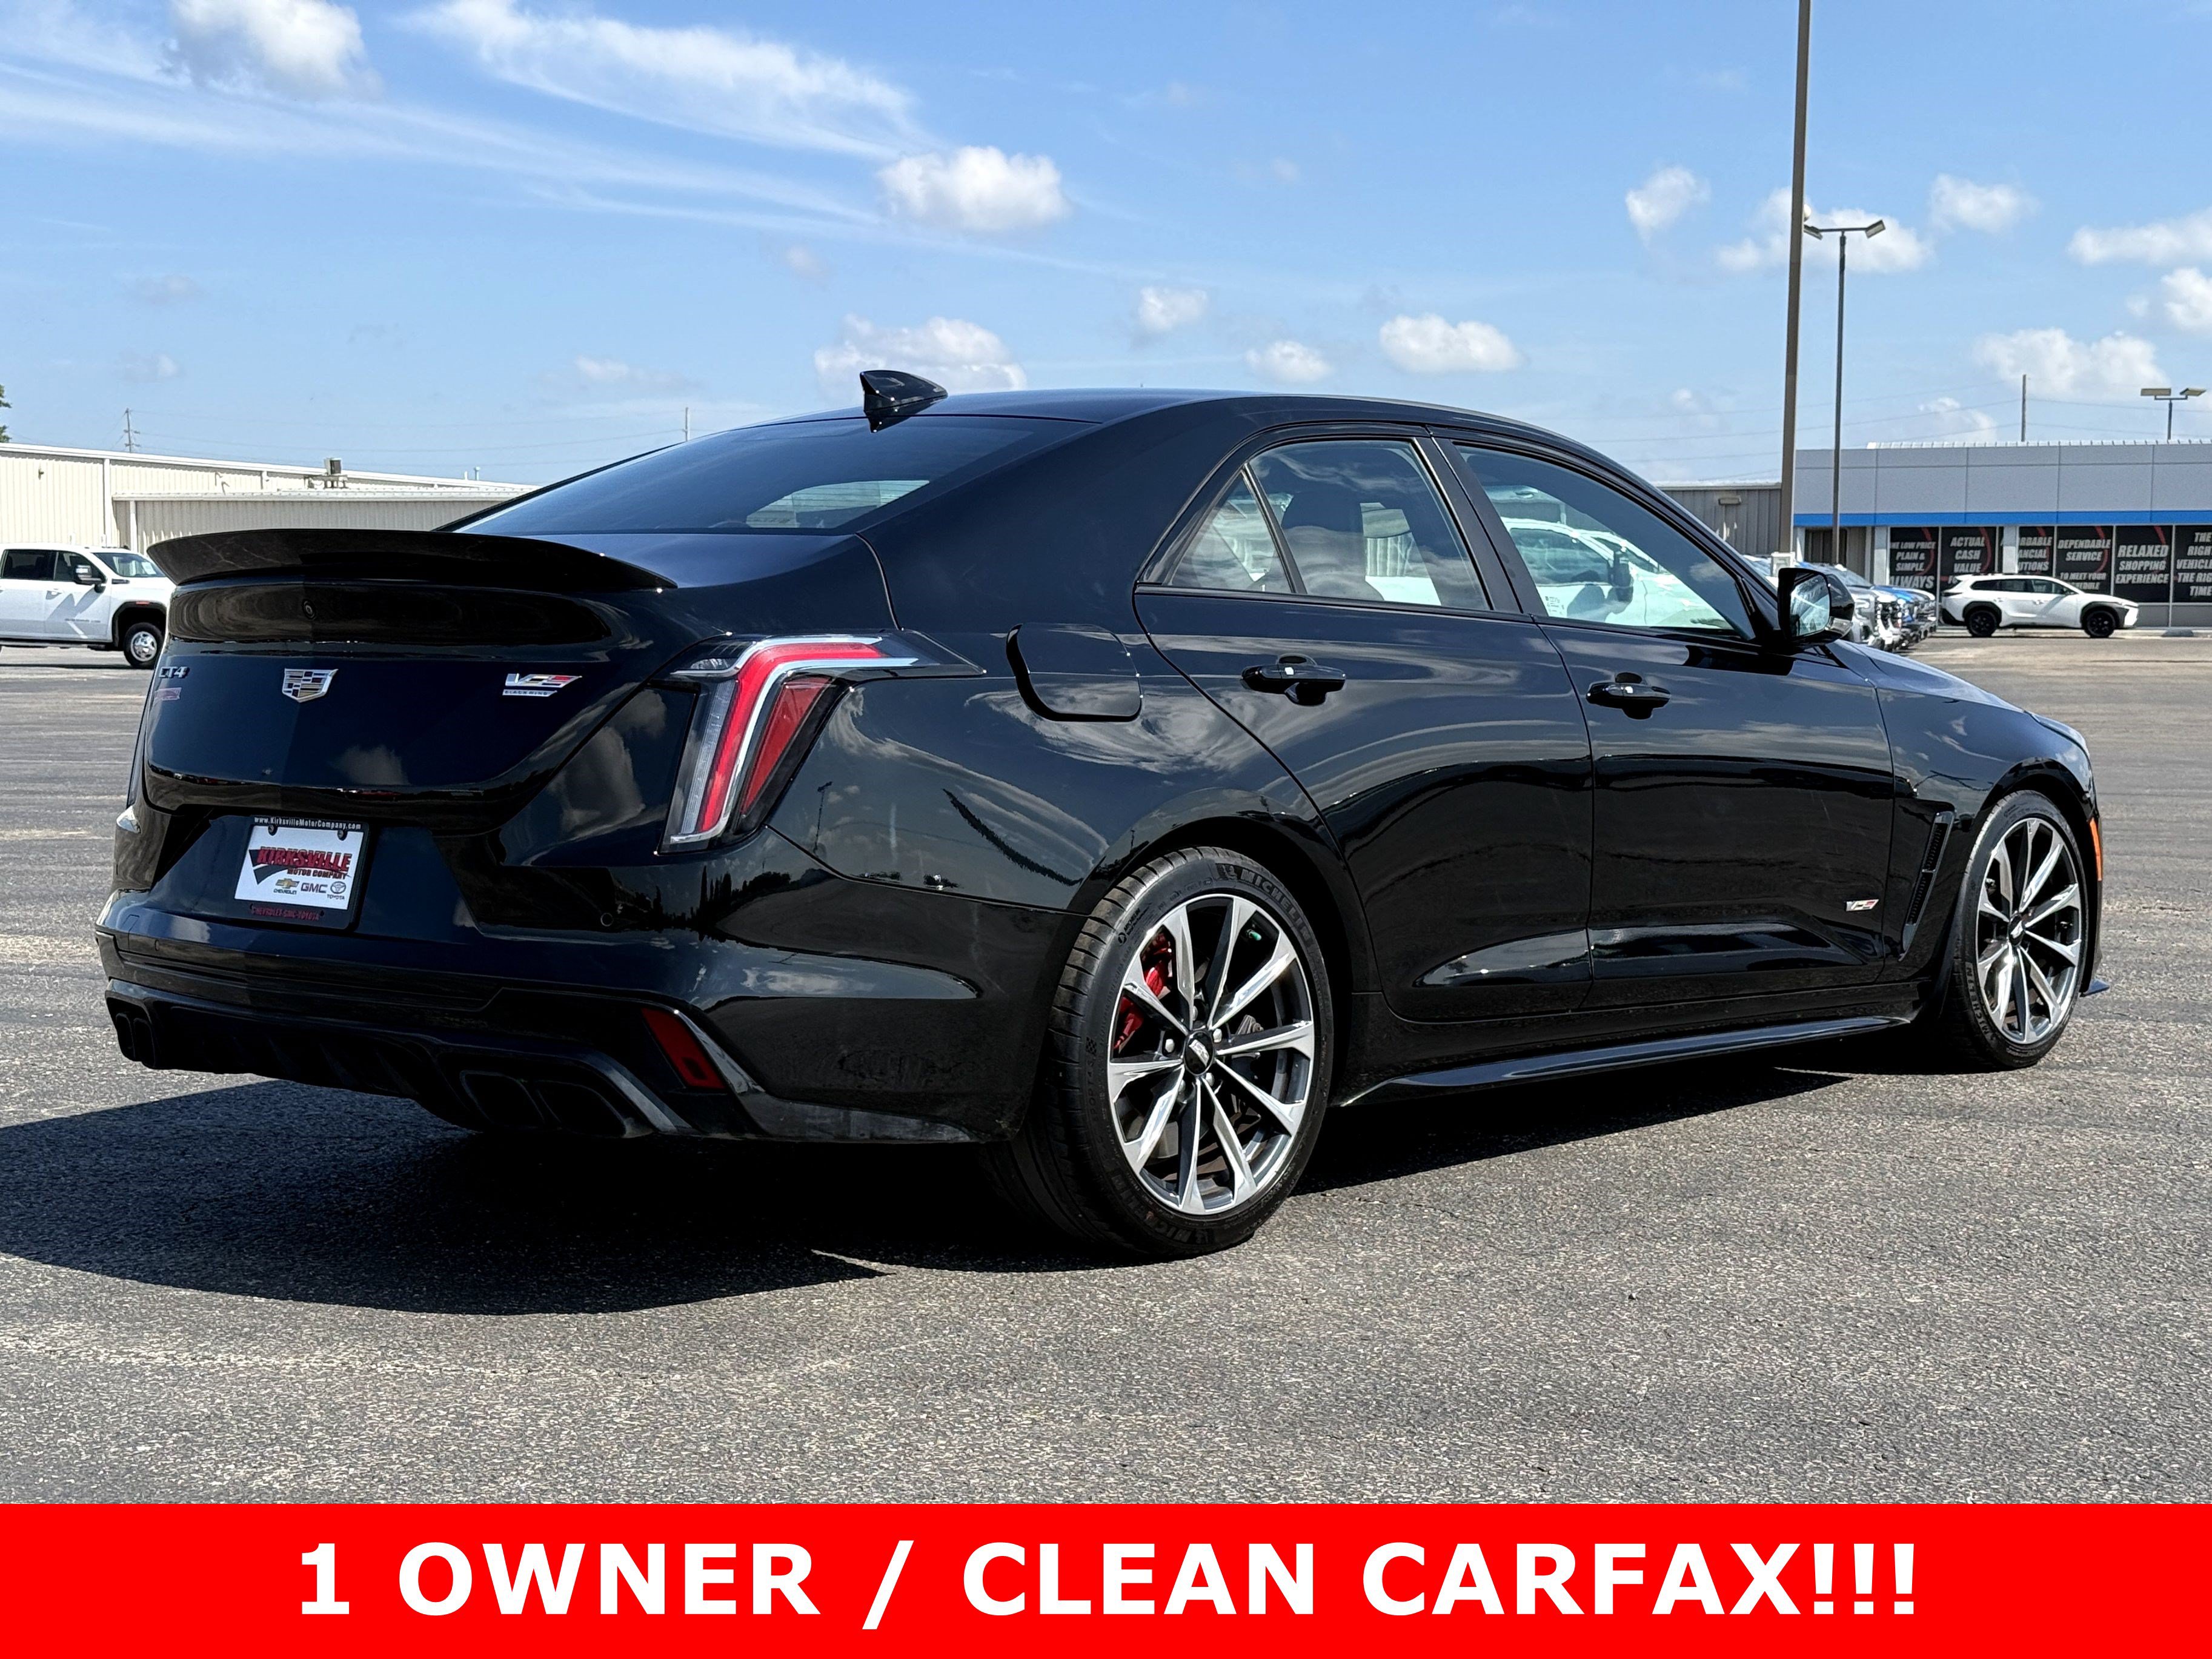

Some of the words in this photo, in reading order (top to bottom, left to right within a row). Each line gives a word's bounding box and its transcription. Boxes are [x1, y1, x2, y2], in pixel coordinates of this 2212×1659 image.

[1950, 537, 1985, 547] ACTUAL
[2194, 532, 2212, 543] THE
[2058, 539, 2111, 549] DEPENDABLE
[1896, 551, 1919, 560] PLAIN
[1955, 550, 1981, 560] CASH
[2018, 549, 2047, 559] ANCIAL
[2117, 545, 2169, 557] RELAXED
[2187, 545, 2212, 556] RIGH
[2065, 551, 2103, 562] SERVICE
[1895, 562, 1925, 572] SIMPLE
[1953, 563, 1982, 573] VALUE
[2018, 561, 2049, 571] UTIONS
[2119, 560, 2167, 571] SHOPPING
[2115, 573, 2169, 584] EXPERIENCE
[2177, 573, 2196, 582] THE
[2196, 573, 2212, 582] RIG
[2190, 586, 2212, 597] TIME
[159, 666, 189, 678] CT4
[254, 817, 362, 830] www.KirksvilleMotorCompany.com
[256, 846, 353, 872] KIRKSVILLE
[287, 868, 311, 877] MOTOR
[313, 869, 347, 879] COMPANY
[301, 883, 328, 894] GMC
[1240, 869, 1312, 942] MICHELIN
